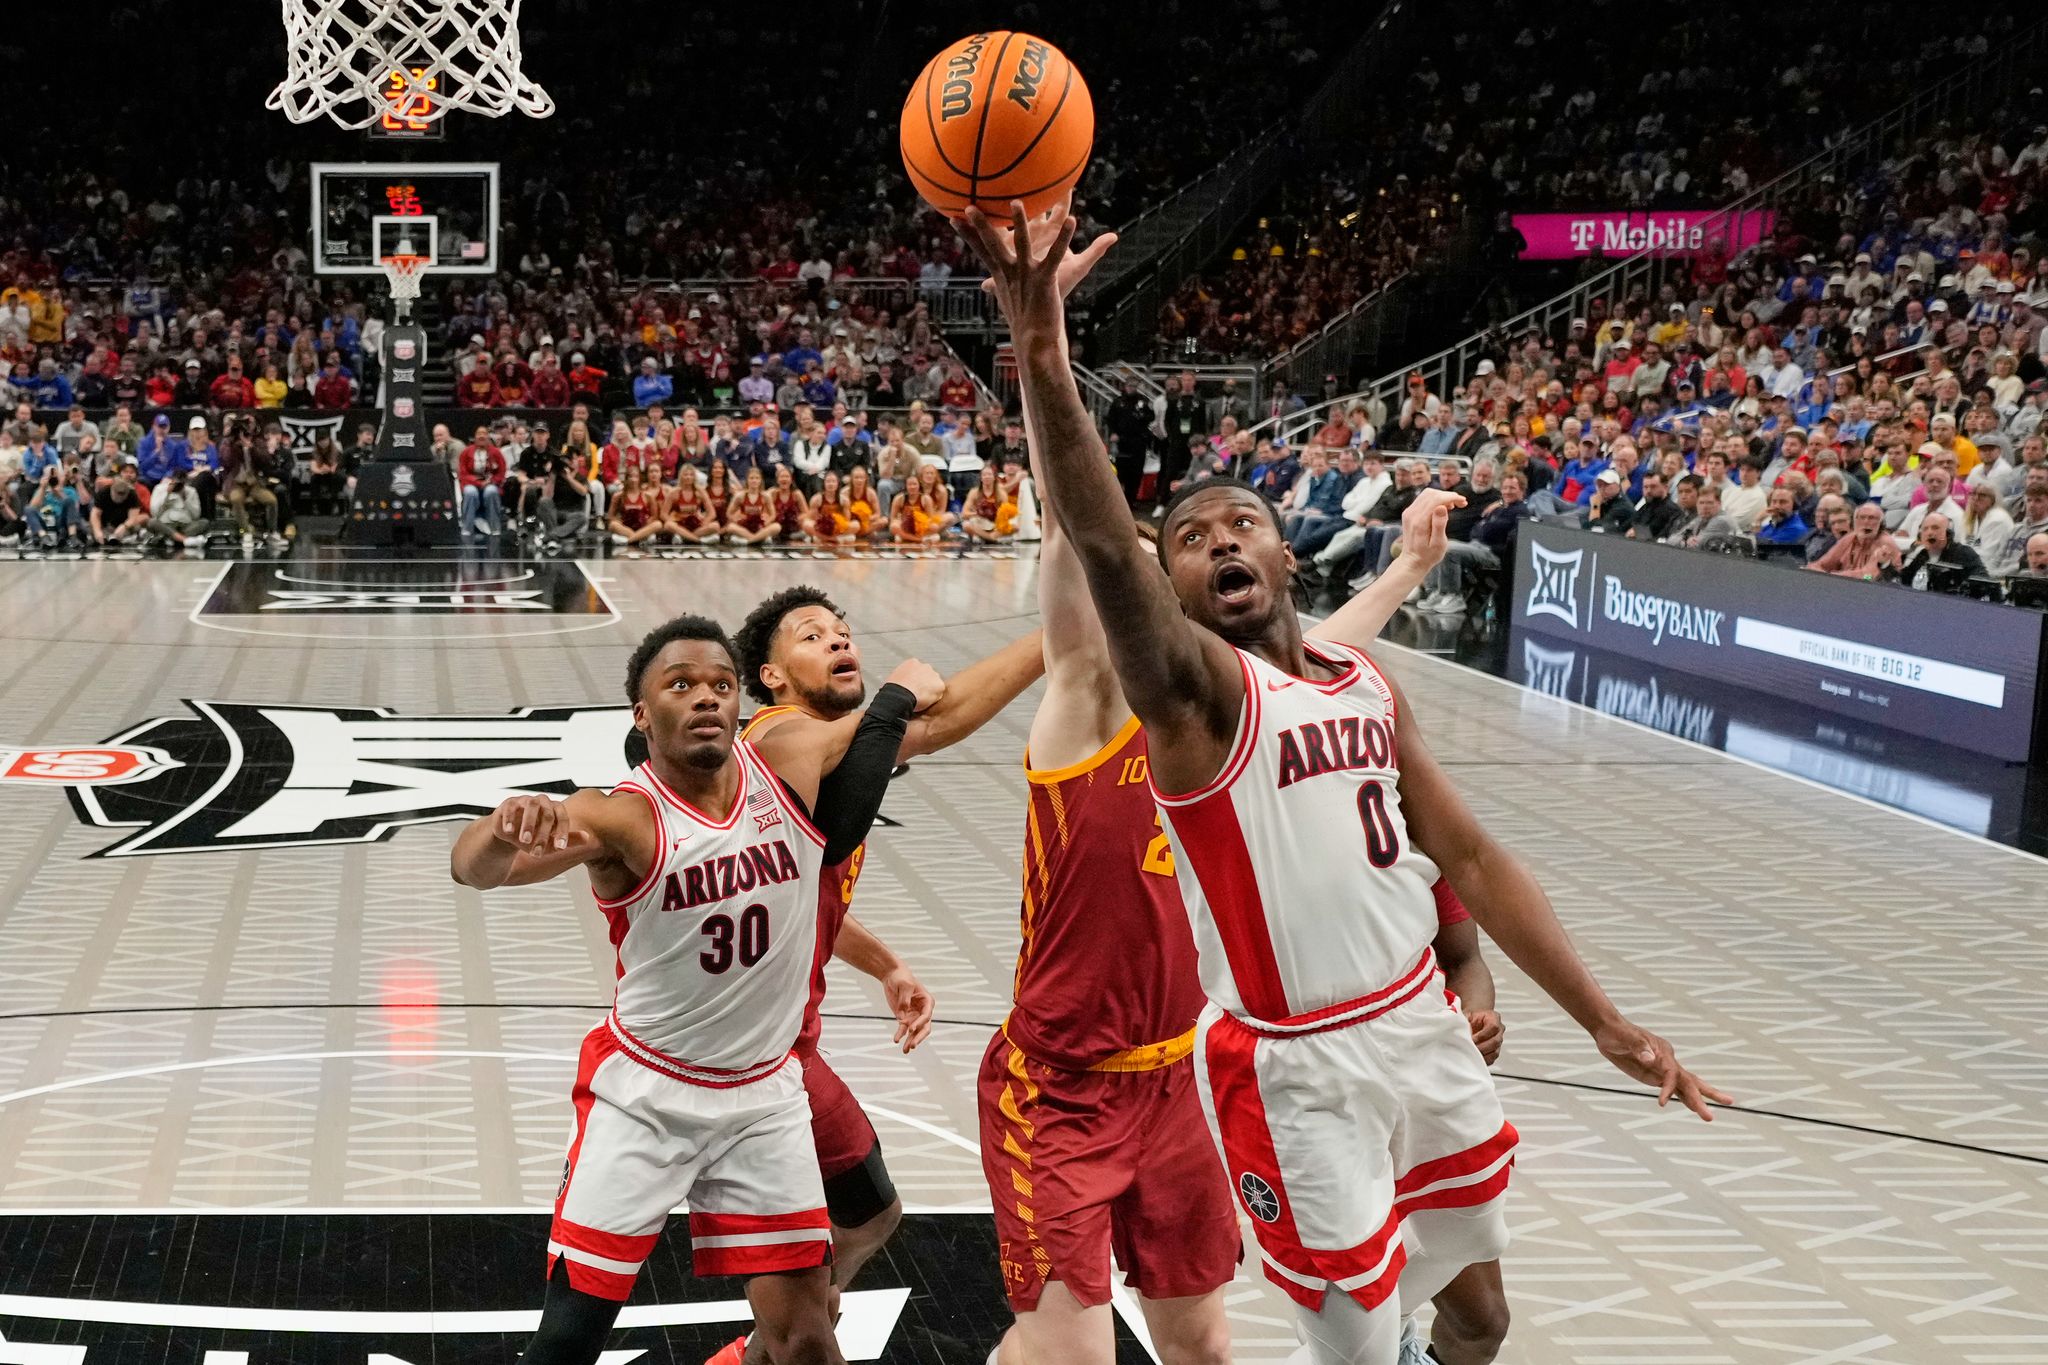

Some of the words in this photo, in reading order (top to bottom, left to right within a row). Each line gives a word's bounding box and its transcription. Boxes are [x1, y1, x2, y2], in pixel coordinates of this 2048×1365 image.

[942, 33, 988, 122] Wilso
[1007, 40, 1050, 111] NCAA
[1602, 219, 1703, 250] Mobile
[1800, 640, 1829, 659] OFFICIAL
[1832, 647, 1849, 663] BANK
[1852, 651, 1861, 666] OF
[1864, 654, 1876, 670] THE
[1881, 657, 1903, 677] BIG
[1908, 663, 1922, 681] 12
[1357, 780, 1399, 868] 0
[661, 840, 800, 911] ARIZONA
[700, 904, 770, 974] 30
